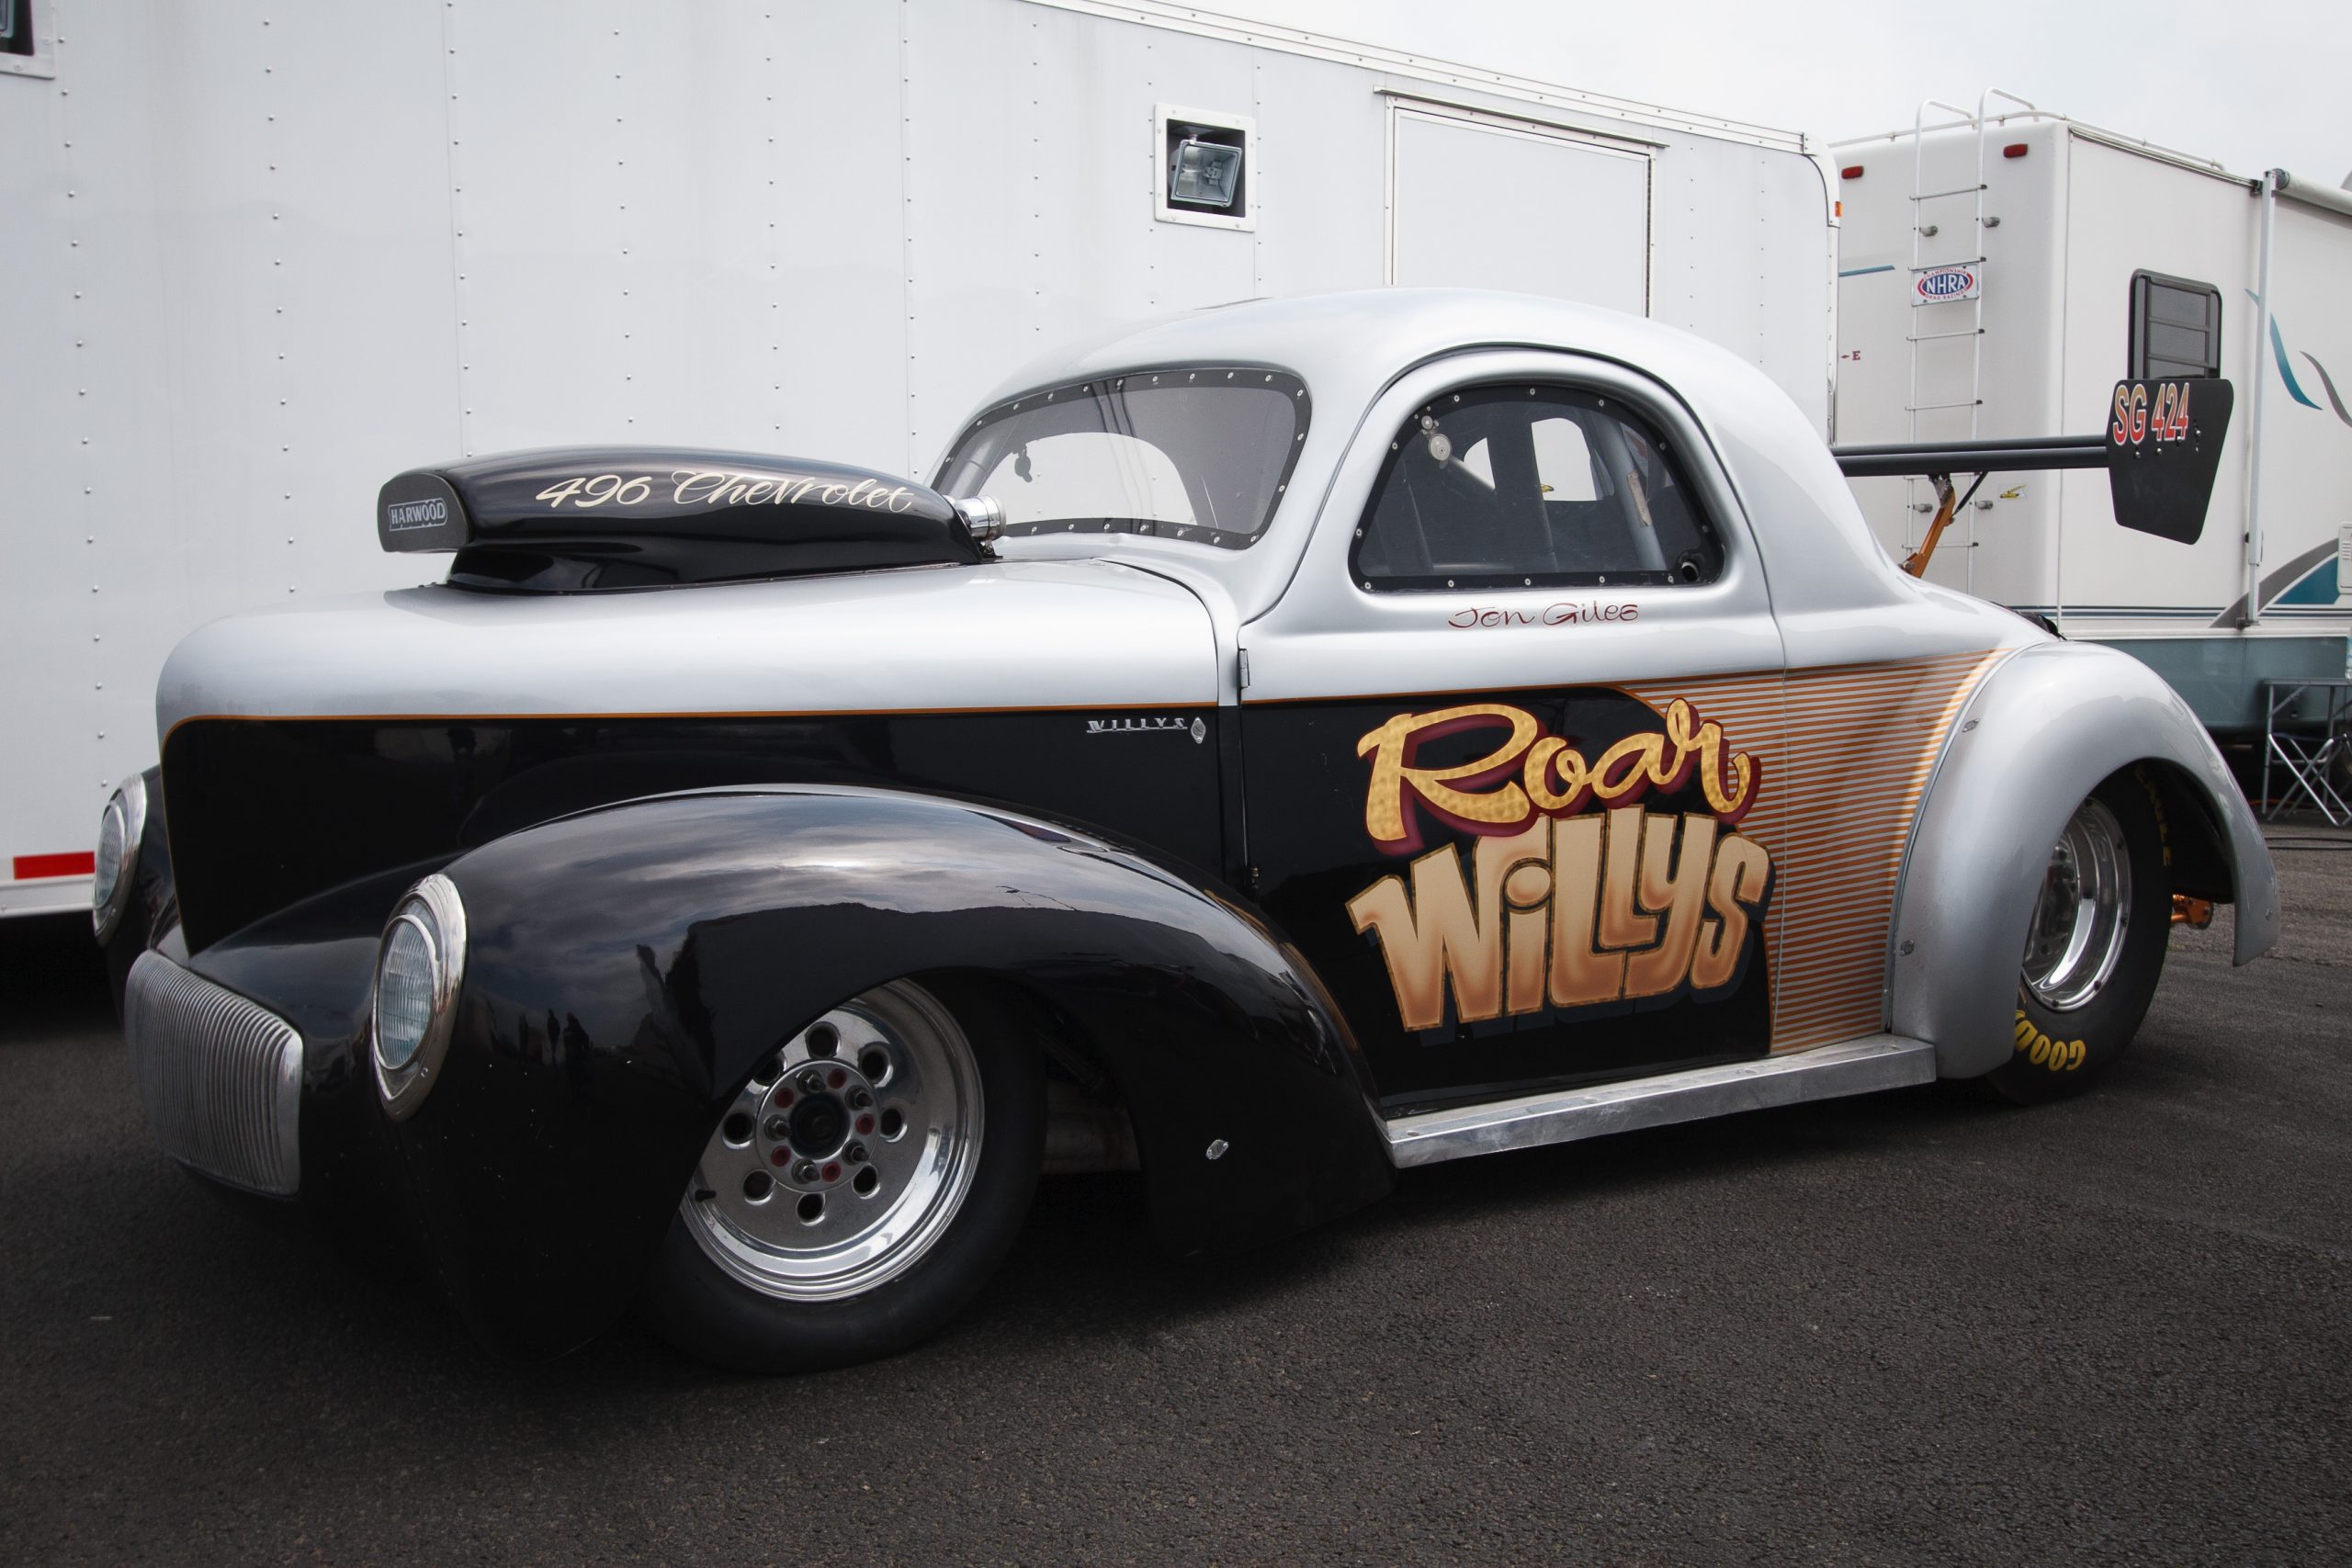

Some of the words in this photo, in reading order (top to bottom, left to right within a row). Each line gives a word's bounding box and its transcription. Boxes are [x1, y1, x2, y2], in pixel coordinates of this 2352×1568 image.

[1926, 275, 1965, 294] NHRA
[2112, 383, 2147, 446] SG
[2151, 382, 2189, 441] 424
[535, 474, 653, 508] 496
[671, 470, 913, 513] Chevrolet
[390, 502, 446, 525] HARWOOD
[1448, 606, 1535, 628] Jon
[1543, 600, 1639, 626] Giles
[1086, 716, 1188, 733] WILLYS
[1356, 698, 1757, 847] Roar
